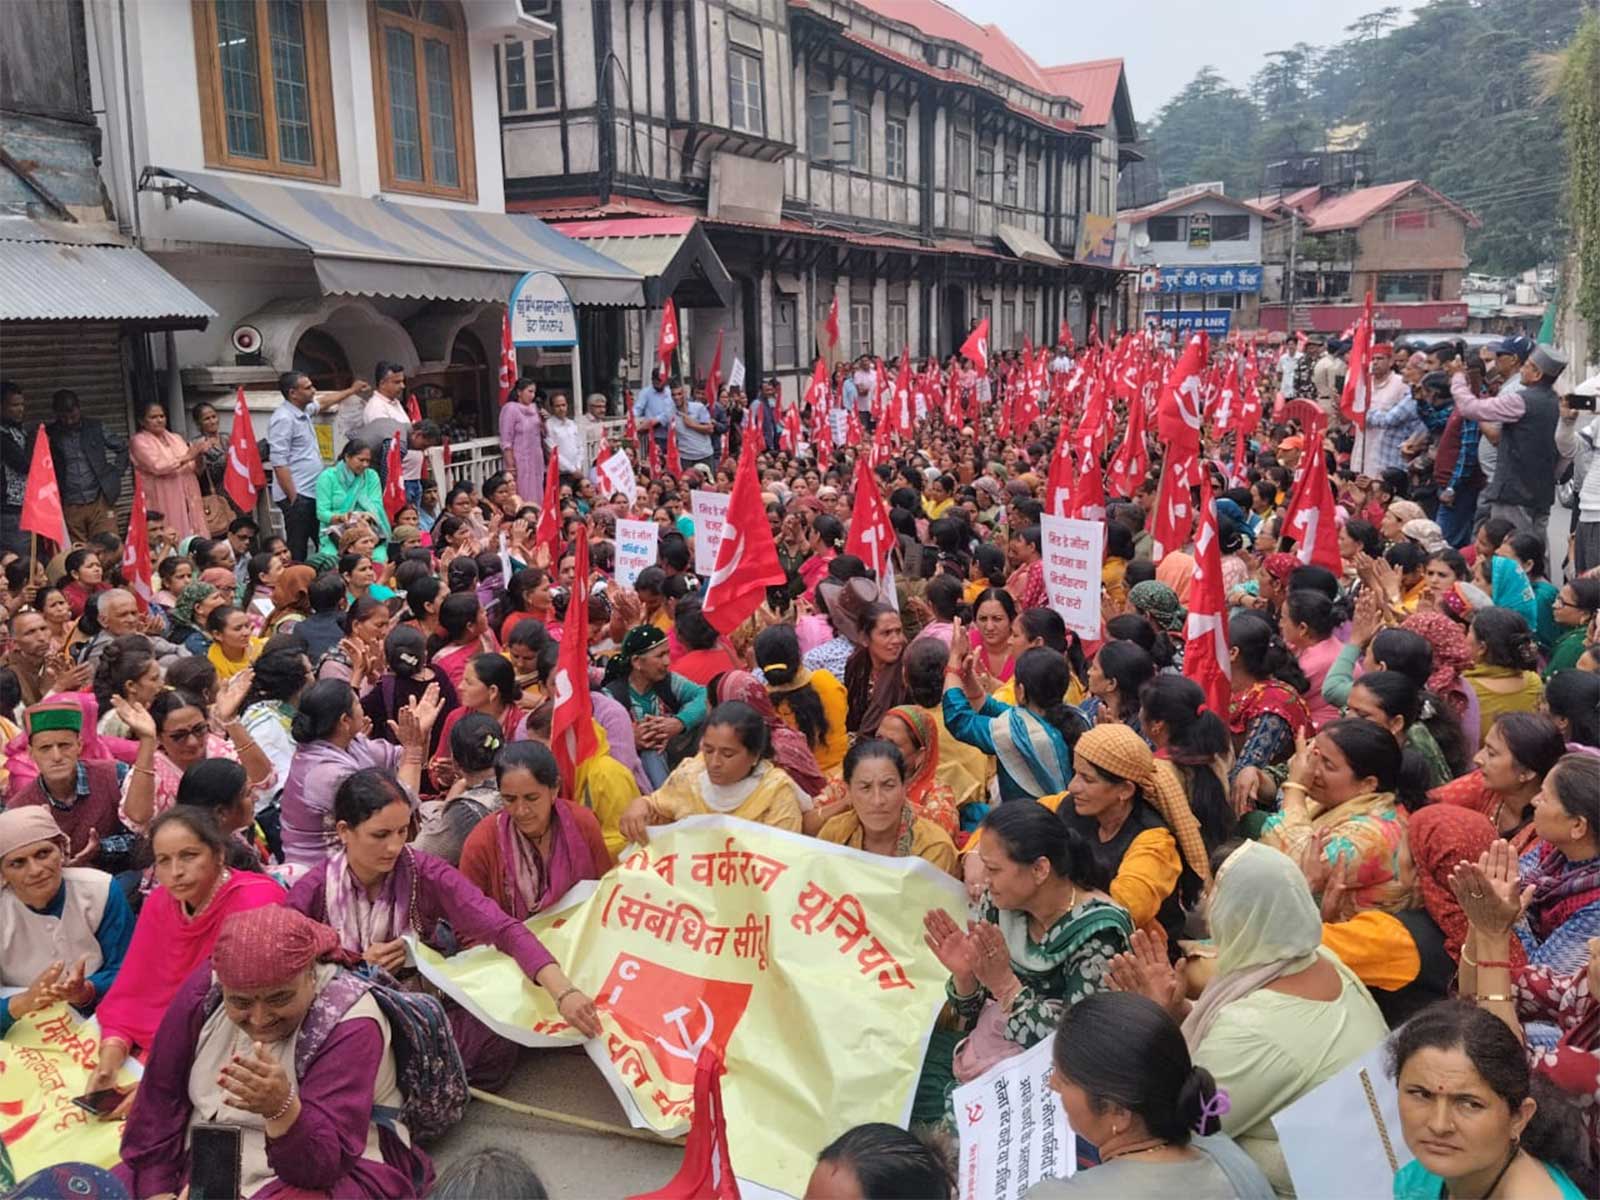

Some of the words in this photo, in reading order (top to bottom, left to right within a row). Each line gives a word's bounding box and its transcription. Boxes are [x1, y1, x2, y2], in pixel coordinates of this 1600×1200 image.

[1219, 270, 1234, 285] सी
[1239, 270, 1258, 285] बैंक
[1194, 317, 1227, 327] BANK
[1069, 536, 1089, 551] मील
[1051, 554, 1074, 568] योजना
[1075, 559, 1087, 570] का
[1055, 593, 1065, 606] बंद
[1065, 596, 1082, 610] करो
[691, 838, 788, 892] वर्करज
[790, 880, 914, 991] यूनियन
[994, 1075, 1010, 1110] लेना
[1000, 1107, 1014, 1129] बंद
[1021, 1103, 1036, 1132] कार्य
[1041, 1101, 1057, 1131] मील
[998, 1127, 1013, 1149] करो
[1020, 1128, 1033, 1144] के
[996, 1146, 1009, 1166] या
[1017, 1143, 1030, 1182] अलावा
